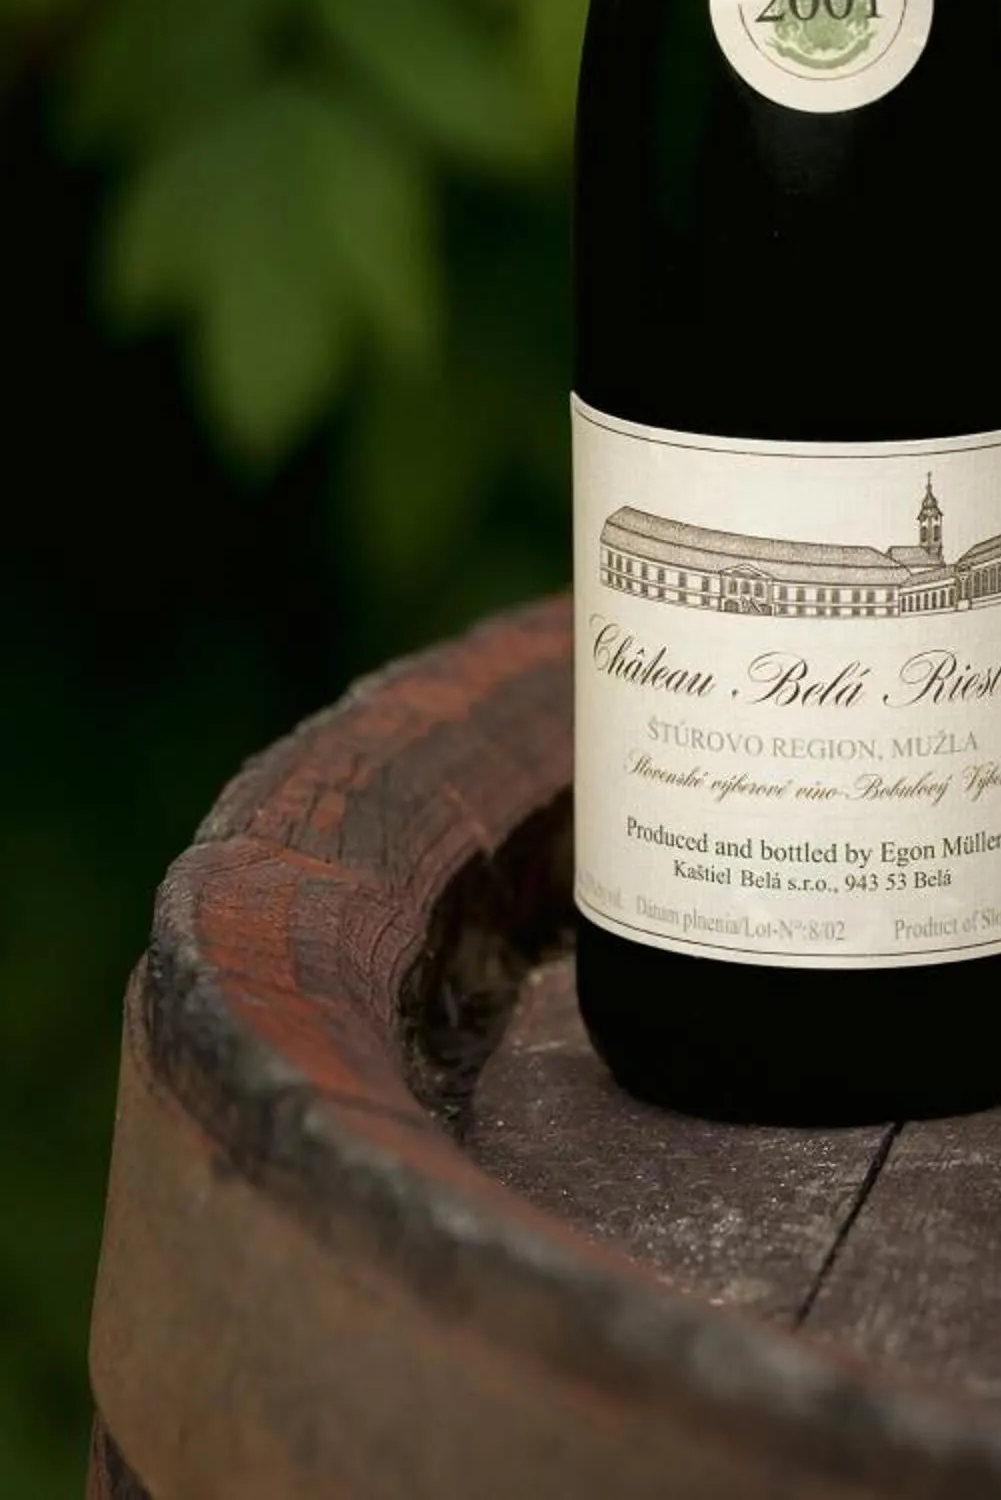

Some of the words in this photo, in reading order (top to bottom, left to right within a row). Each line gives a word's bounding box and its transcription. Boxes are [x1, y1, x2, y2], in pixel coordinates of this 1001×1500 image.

[589, 612, 716, 697] Château
[731, 650, 872, 708] Belá
[647, 715, 764, 756] ŠTÚROVO
[772, 736, 883, 761] REGION,
[892, 729, 978, 759] MUŽLA
[627, 816, 708, 853] Produced
[715, 839, 753, 859] and
[760, 840, 837, 863] bottled
[845, 844, 873, 869] by
[881, 841, 935, 867] Egon
[674, 860, 731, 885] Kaštiel
[741, 870, 781, 890] Belá
[788, 878, 839, 894] s.r.o.,
[845, 873, 879, 891] 943
[886, 873, 907, 891] 53
[915, 870, 952, 889] Belá
[894, 916, 957, 942] Product
